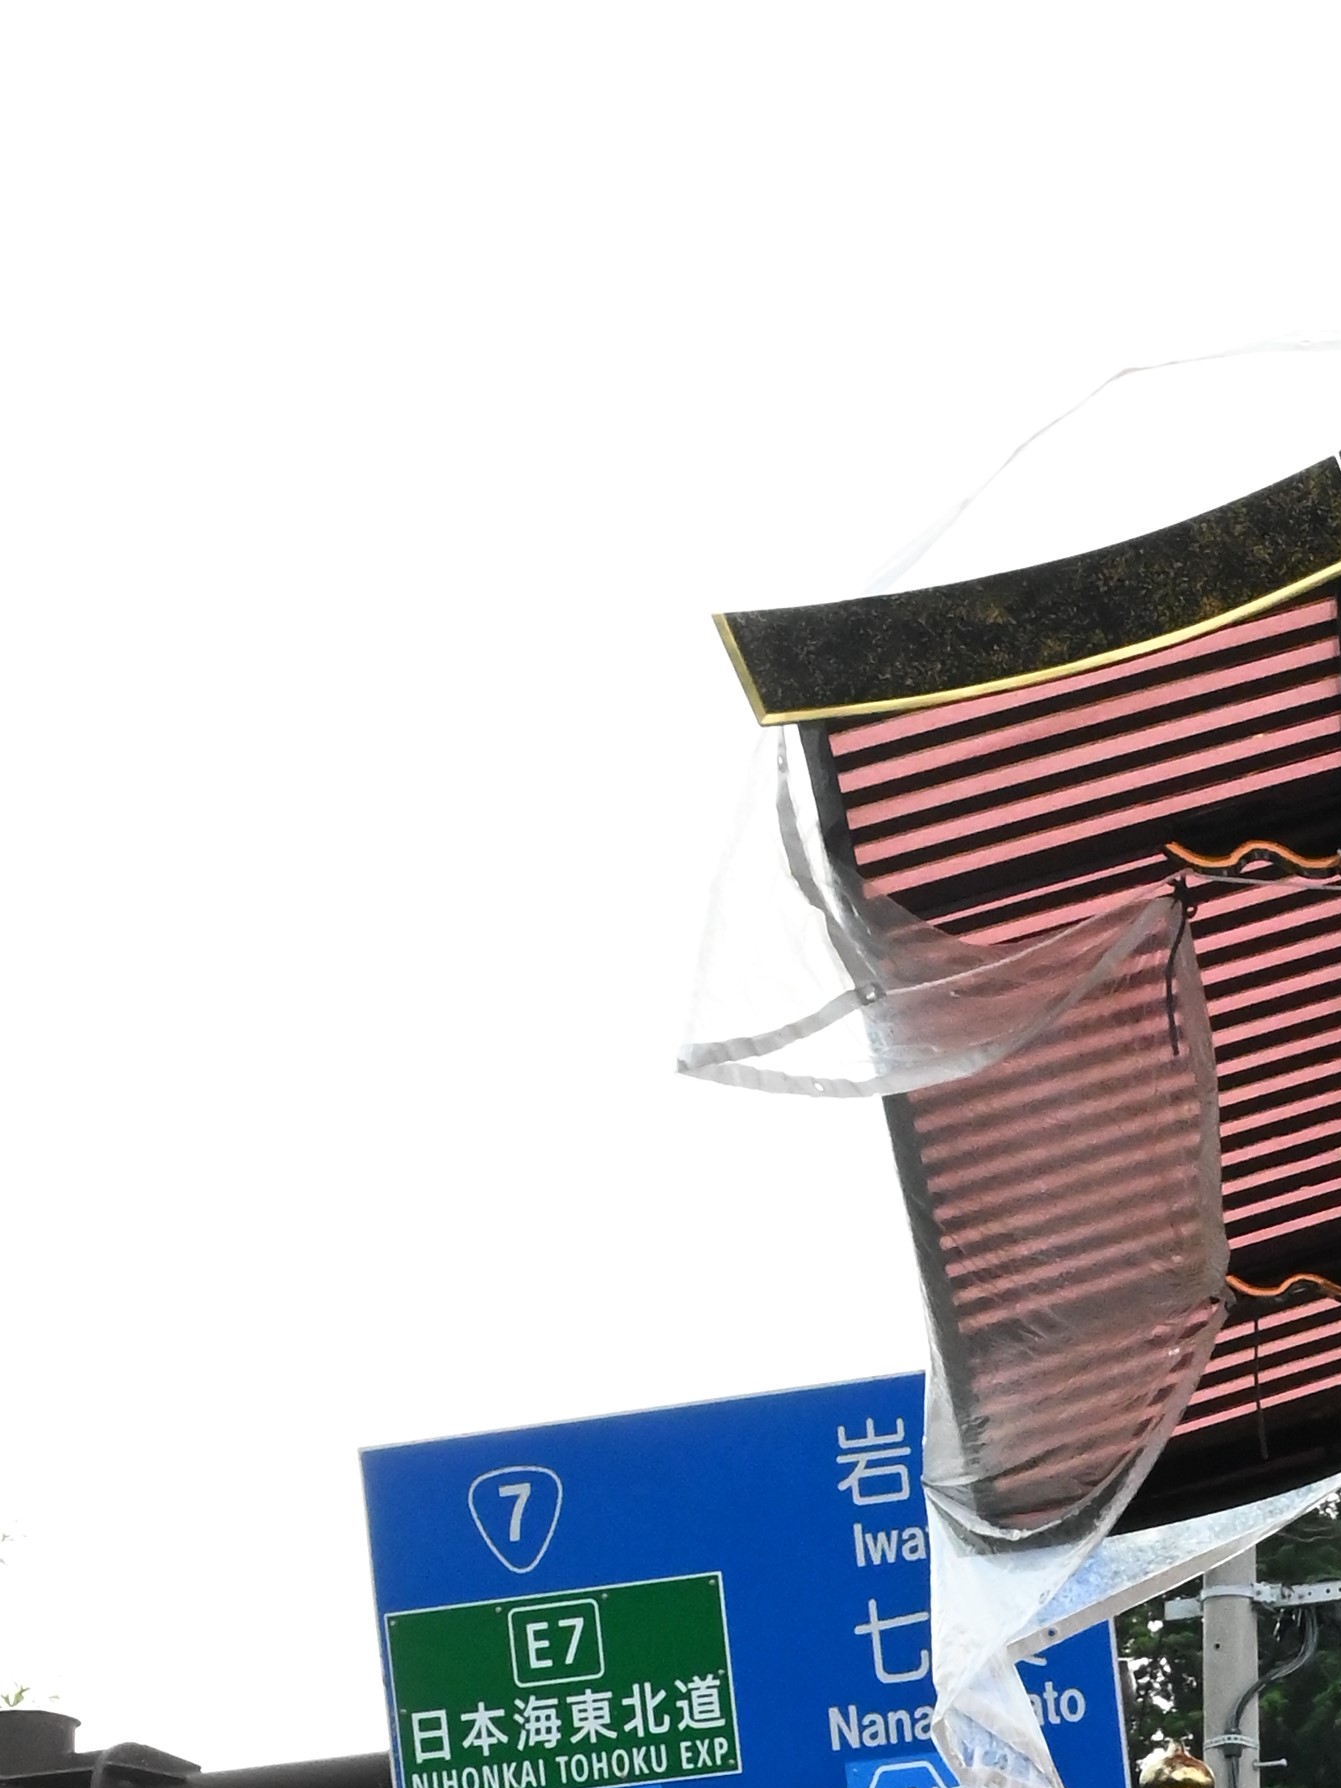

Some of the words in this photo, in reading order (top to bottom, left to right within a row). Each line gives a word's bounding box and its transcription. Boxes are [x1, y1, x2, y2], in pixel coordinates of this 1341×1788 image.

[836, 1417, 912, 1506] 岩
[497, 1483, 532, 1541] 7
[852, 1522, 932, 1568] Iwa
[525, 1616, 585, 1670] E7
[410, 1673, 727, 1764] 日本海東北道
[555, 1743, 668, 1784] TOHOKU
[680, 1736, 729, 1770] EXP
